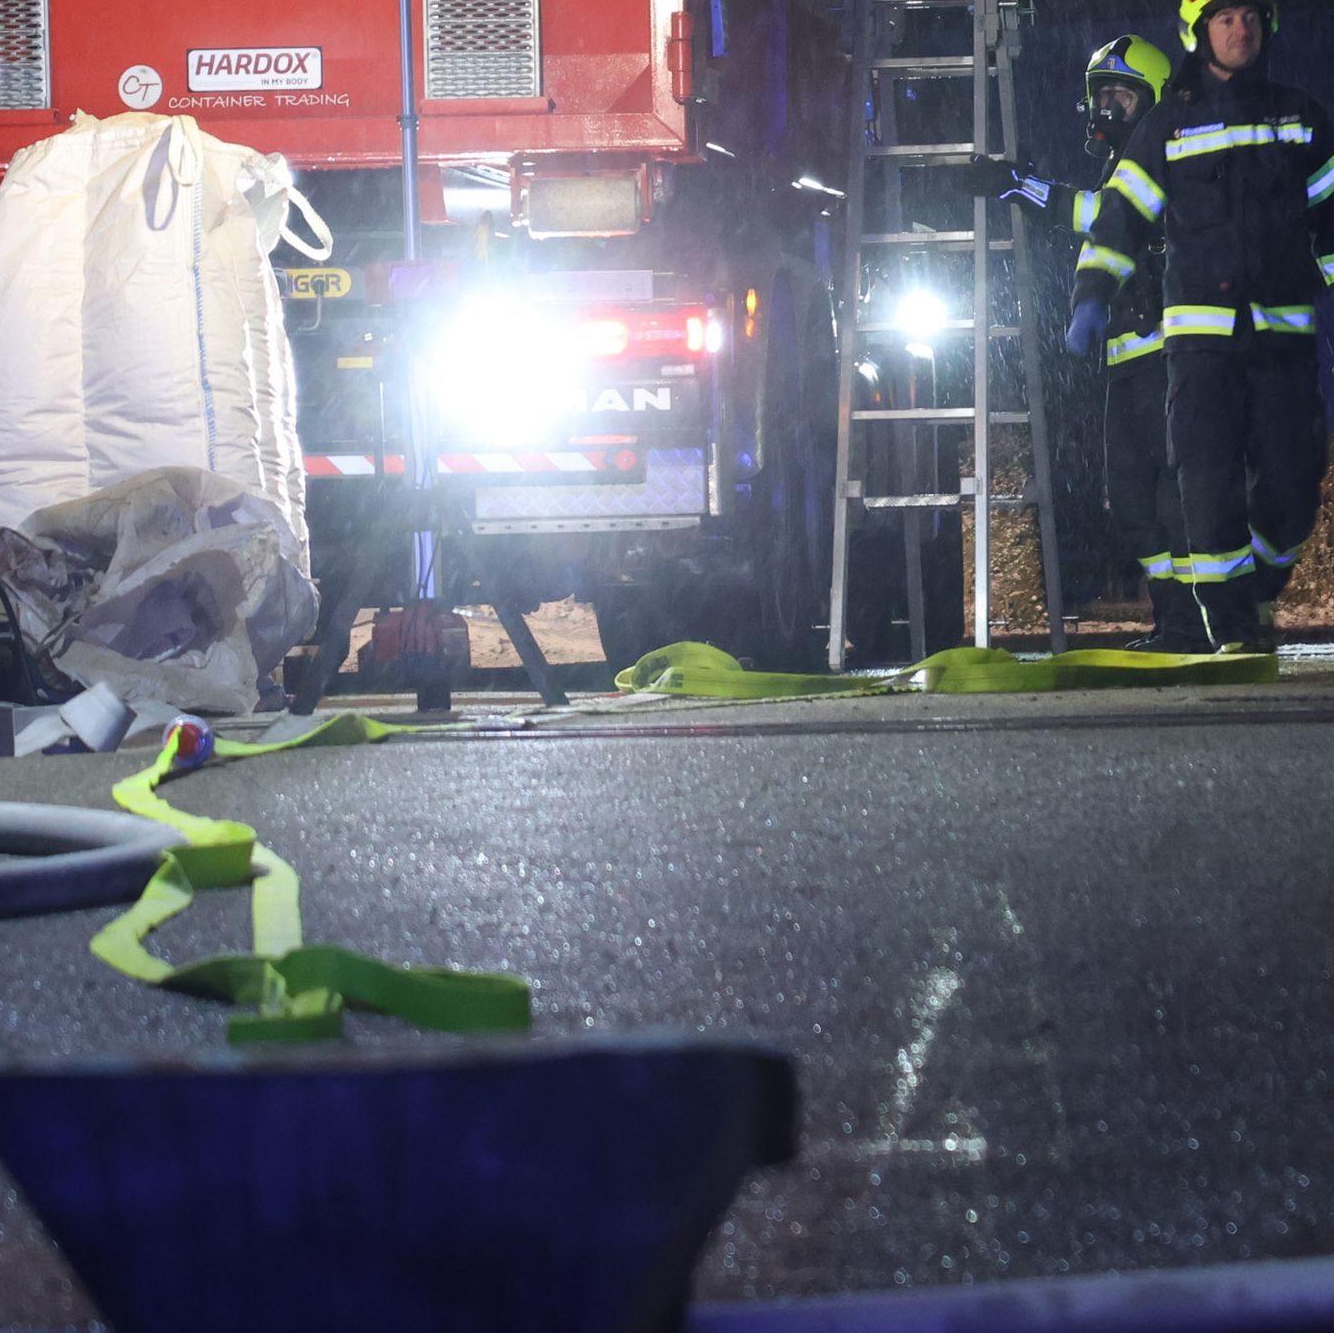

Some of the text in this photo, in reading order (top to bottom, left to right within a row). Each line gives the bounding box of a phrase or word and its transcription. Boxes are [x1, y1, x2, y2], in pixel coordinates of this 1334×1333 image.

[194, 52, 311, 76] HARDOX
[272, 78, 284, 86] MY
[286, 77, 309, 85] BODY
[168, 93, 351, 109] CONTAINER TRADING
